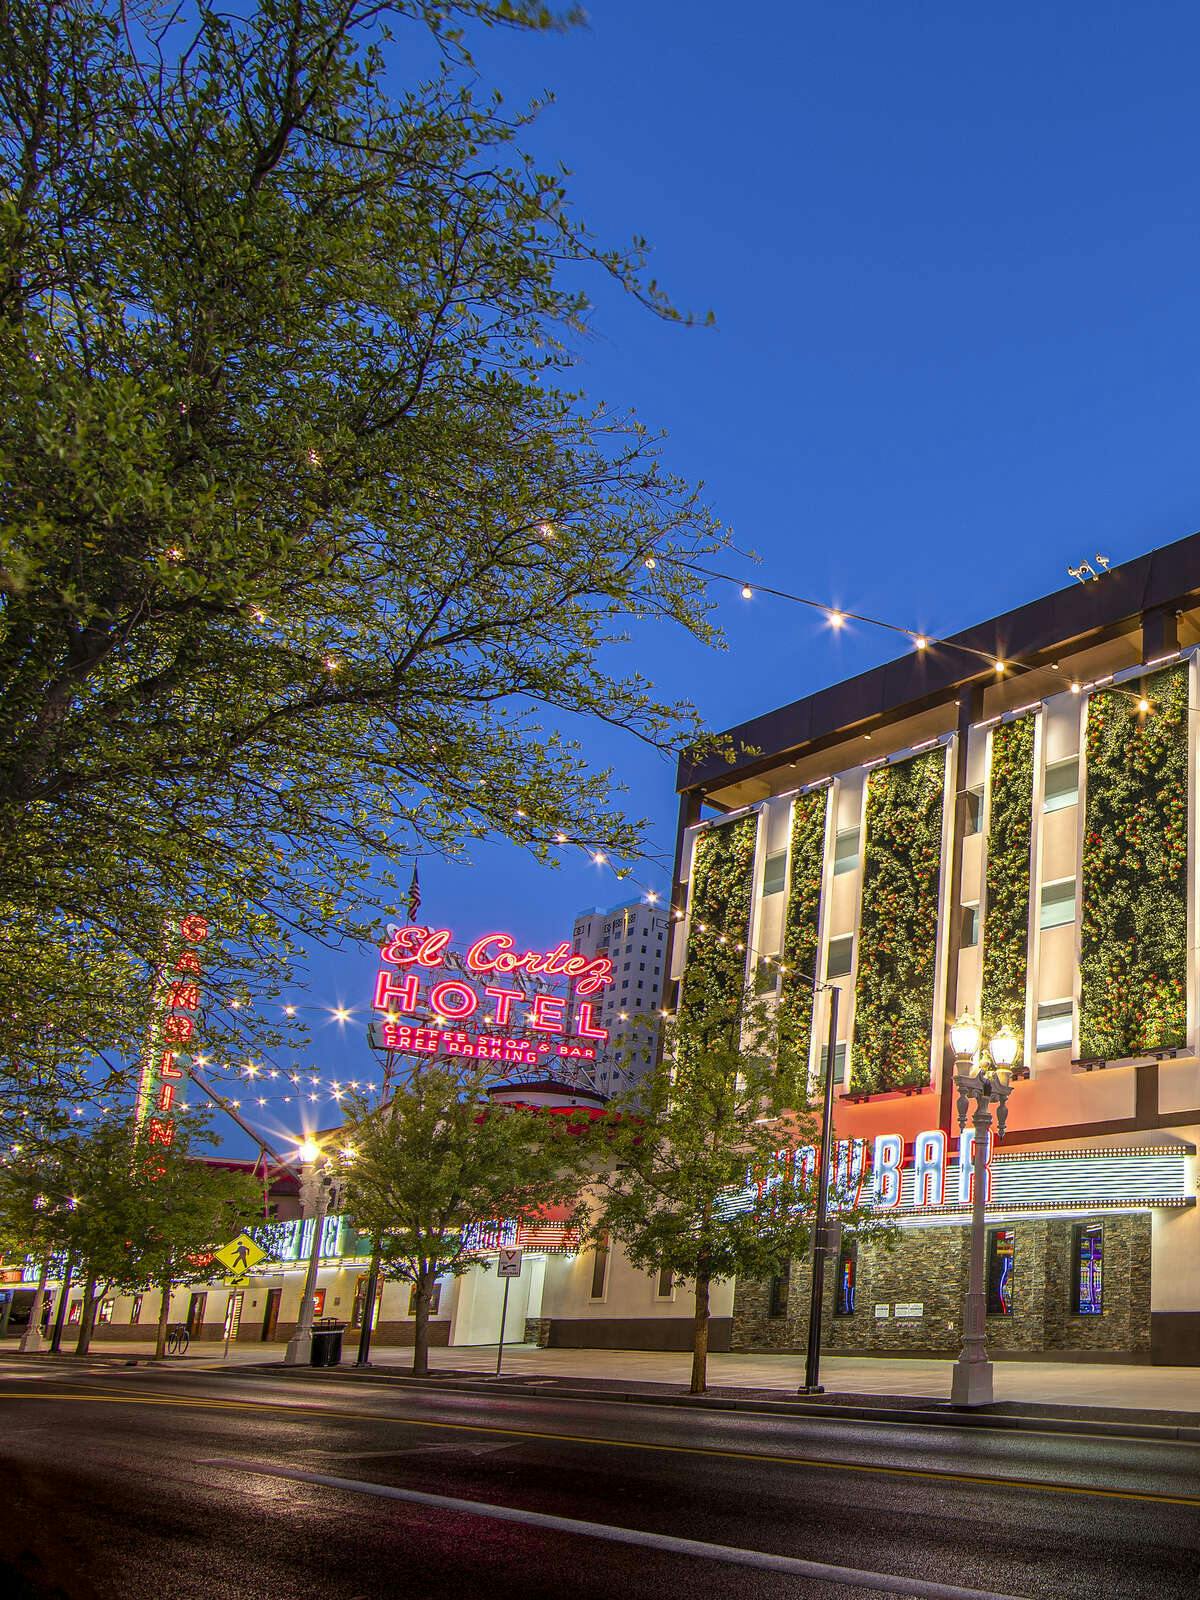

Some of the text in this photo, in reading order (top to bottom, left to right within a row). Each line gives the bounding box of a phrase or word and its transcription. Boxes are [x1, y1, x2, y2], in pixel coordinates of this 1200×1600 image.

[380, 927, 613, 995] El Cortez
[373, 970, 608, 1040] HOTEL
[383, 1024, 595, 1059] COFFEE SHOP & BAR
[386, 1035, 538, 1064] FREE PARKING
